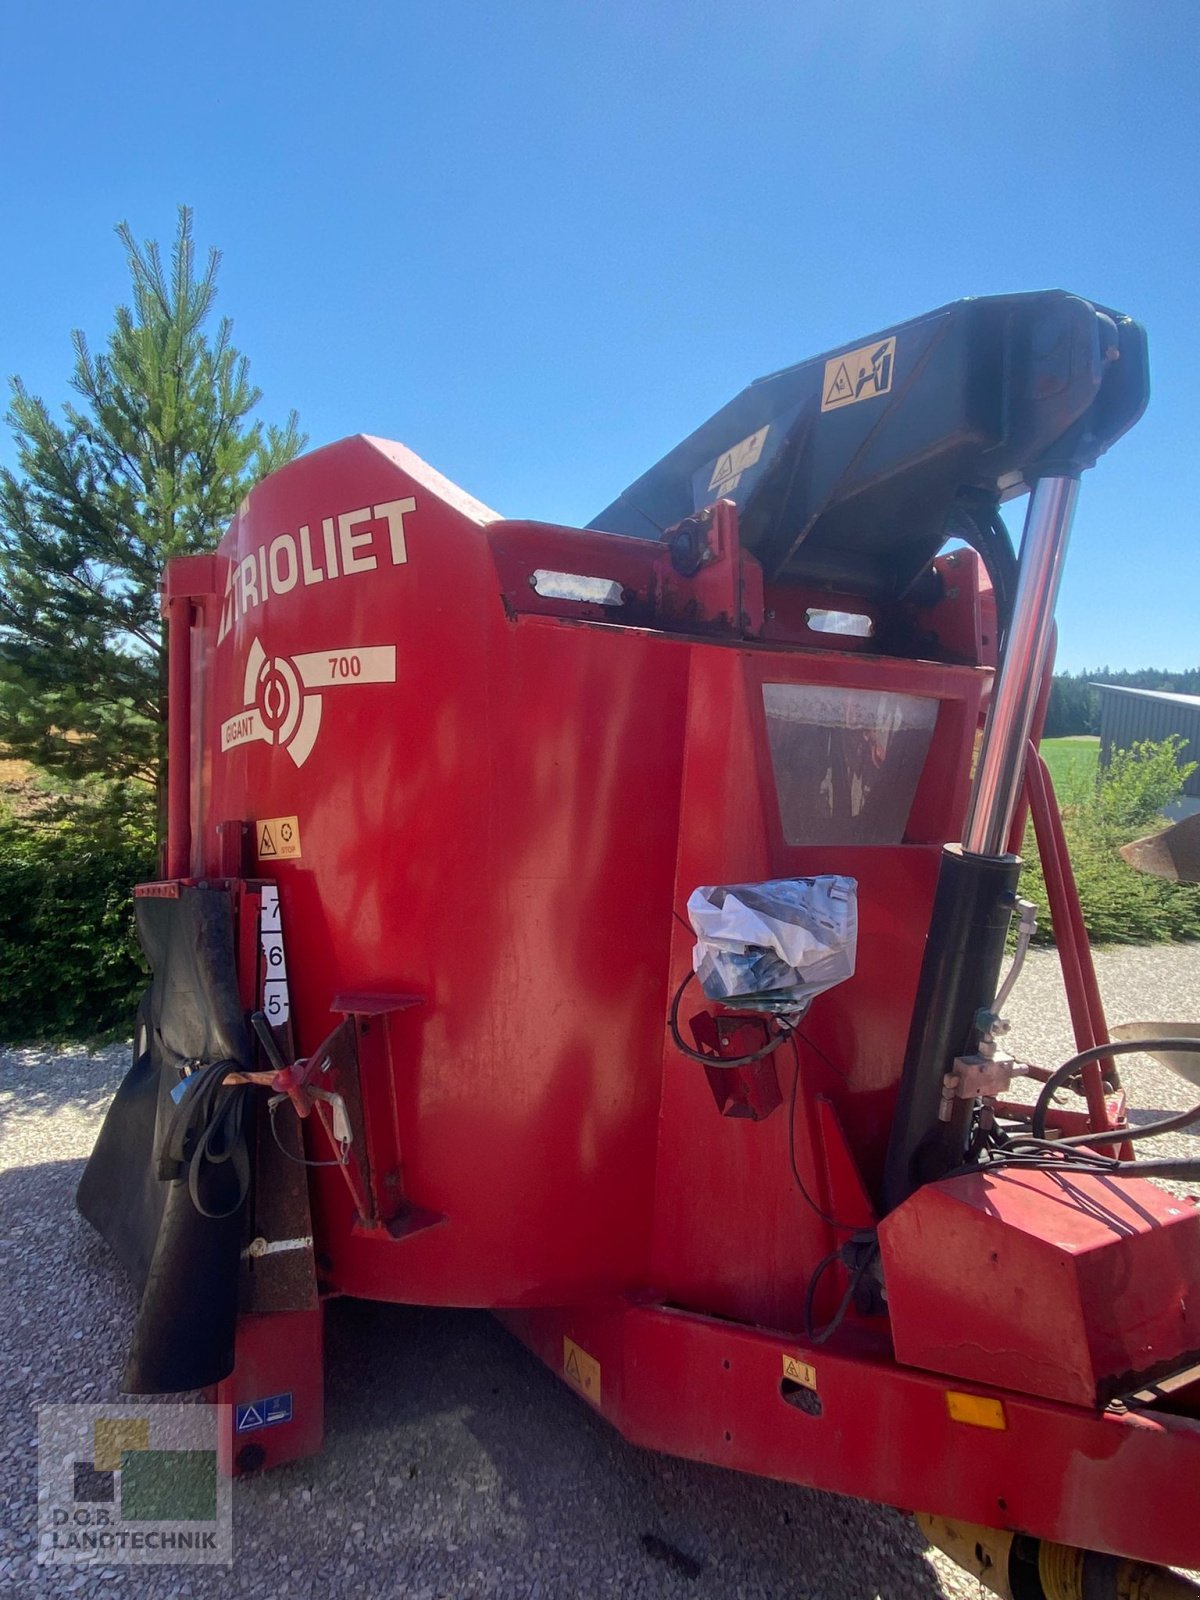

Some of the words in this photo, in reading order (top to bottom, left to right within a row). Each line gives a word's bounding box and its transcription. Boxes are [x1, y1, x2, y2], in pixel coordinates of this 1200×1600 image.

[232, 496, 417, 622] TRIOLIET
[328, 656, 362, 679] 700
[225, 716, 255, 744] GIGANT
[270, 898, 280, 918] 7
[268, 946, 283, 966] 6
[268, 995, 281, 1014] 5
